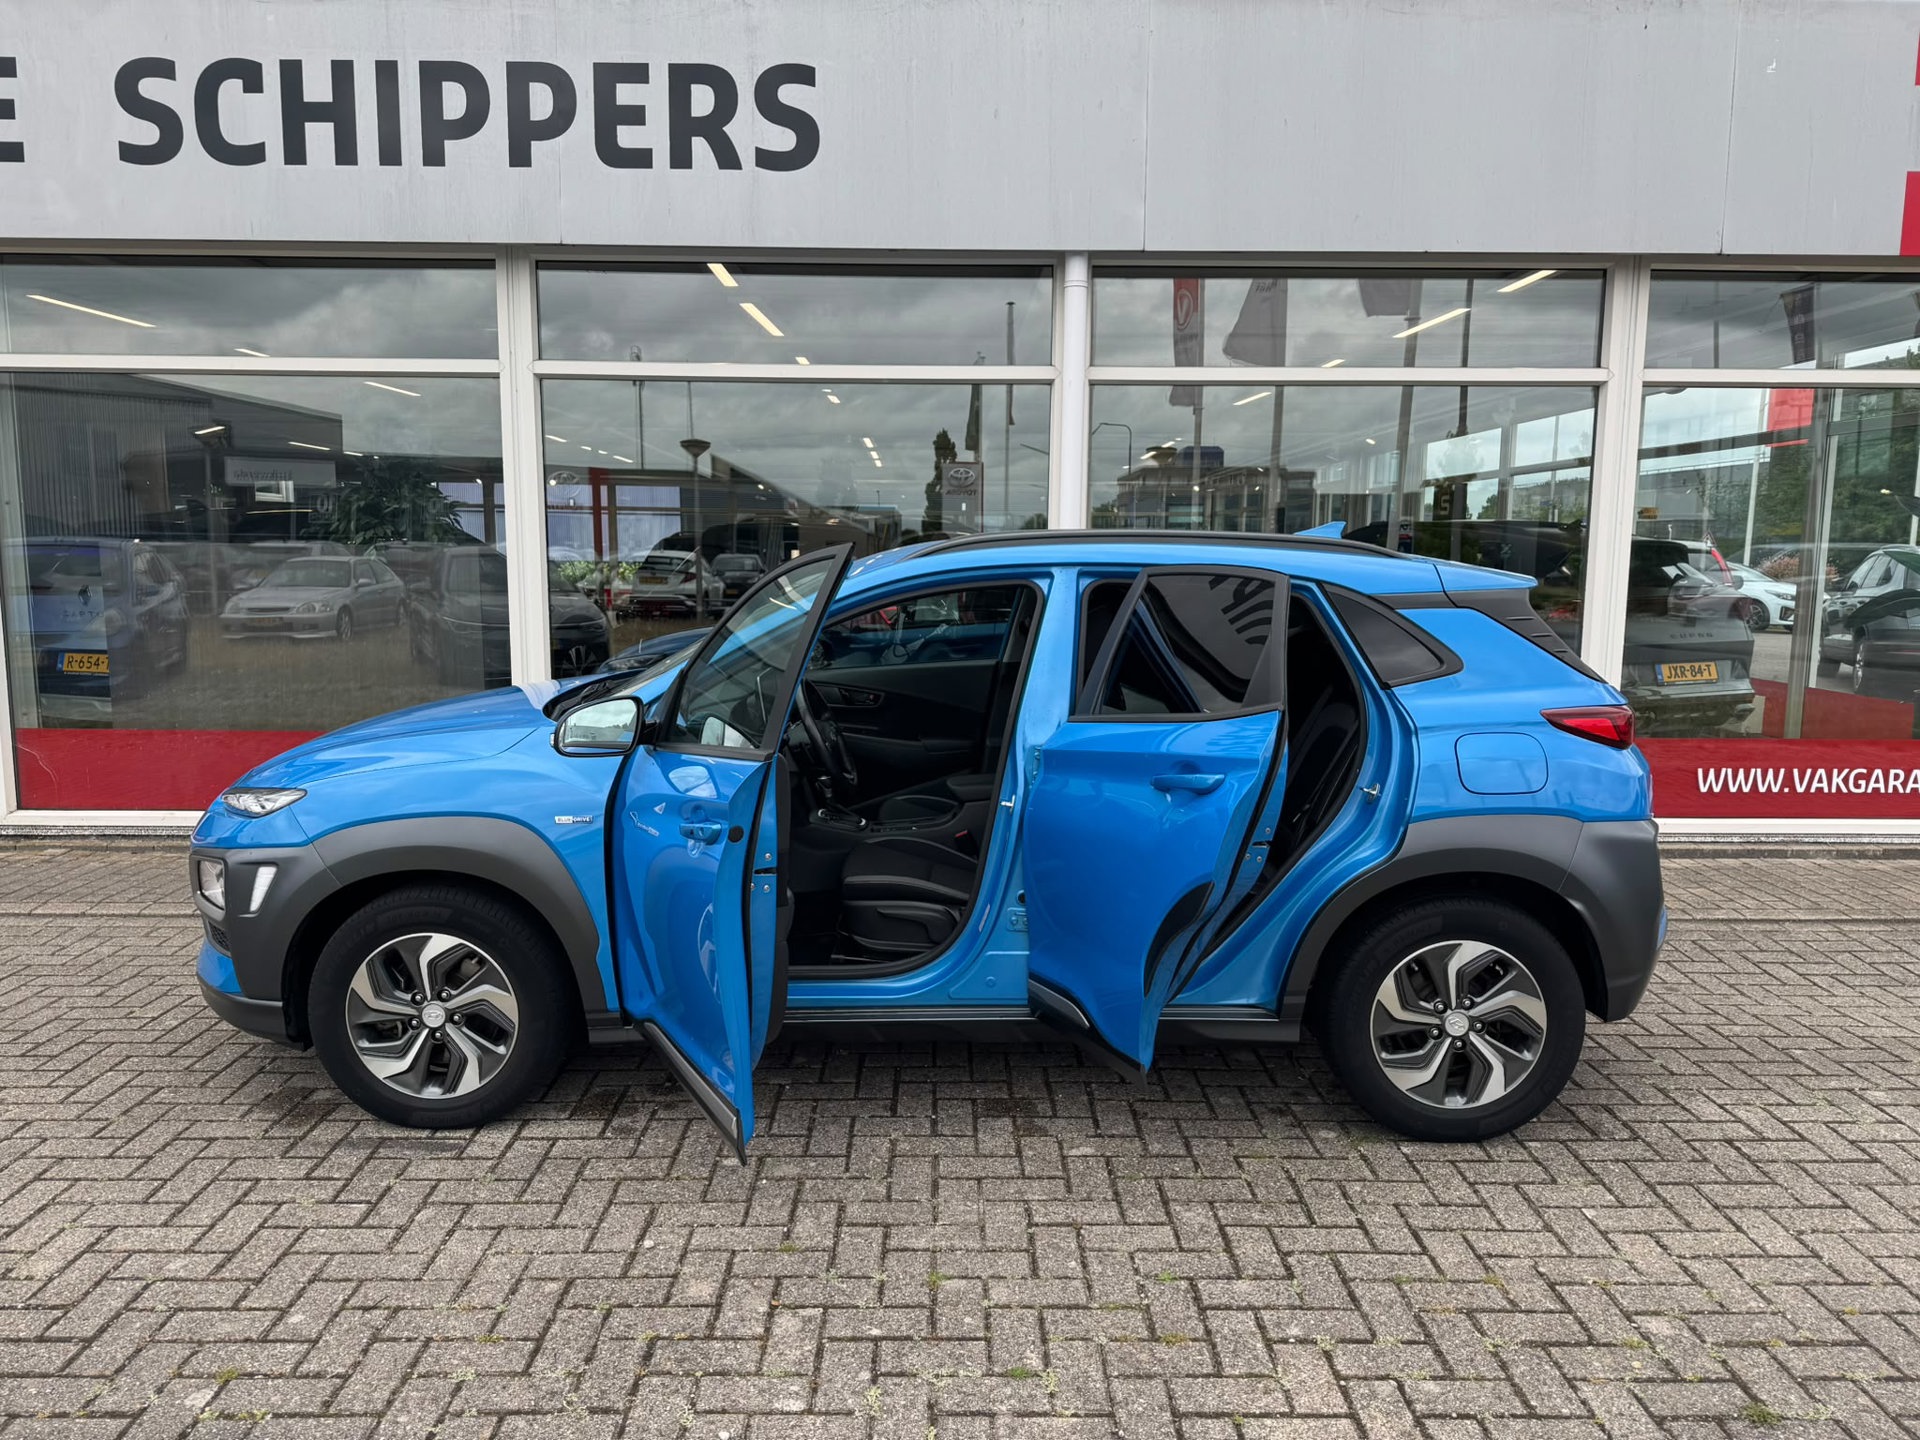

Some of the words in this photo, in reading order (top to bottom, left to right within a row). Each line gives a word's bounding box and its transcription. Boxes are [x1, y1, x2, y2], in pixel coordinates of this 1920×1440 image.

[113, 56, 821, 172] SCHIPPERS
[1667, 664, 1712, 679] JXR-84-T
[1697, 767, 1920, 794] WWW.VAKGARA
